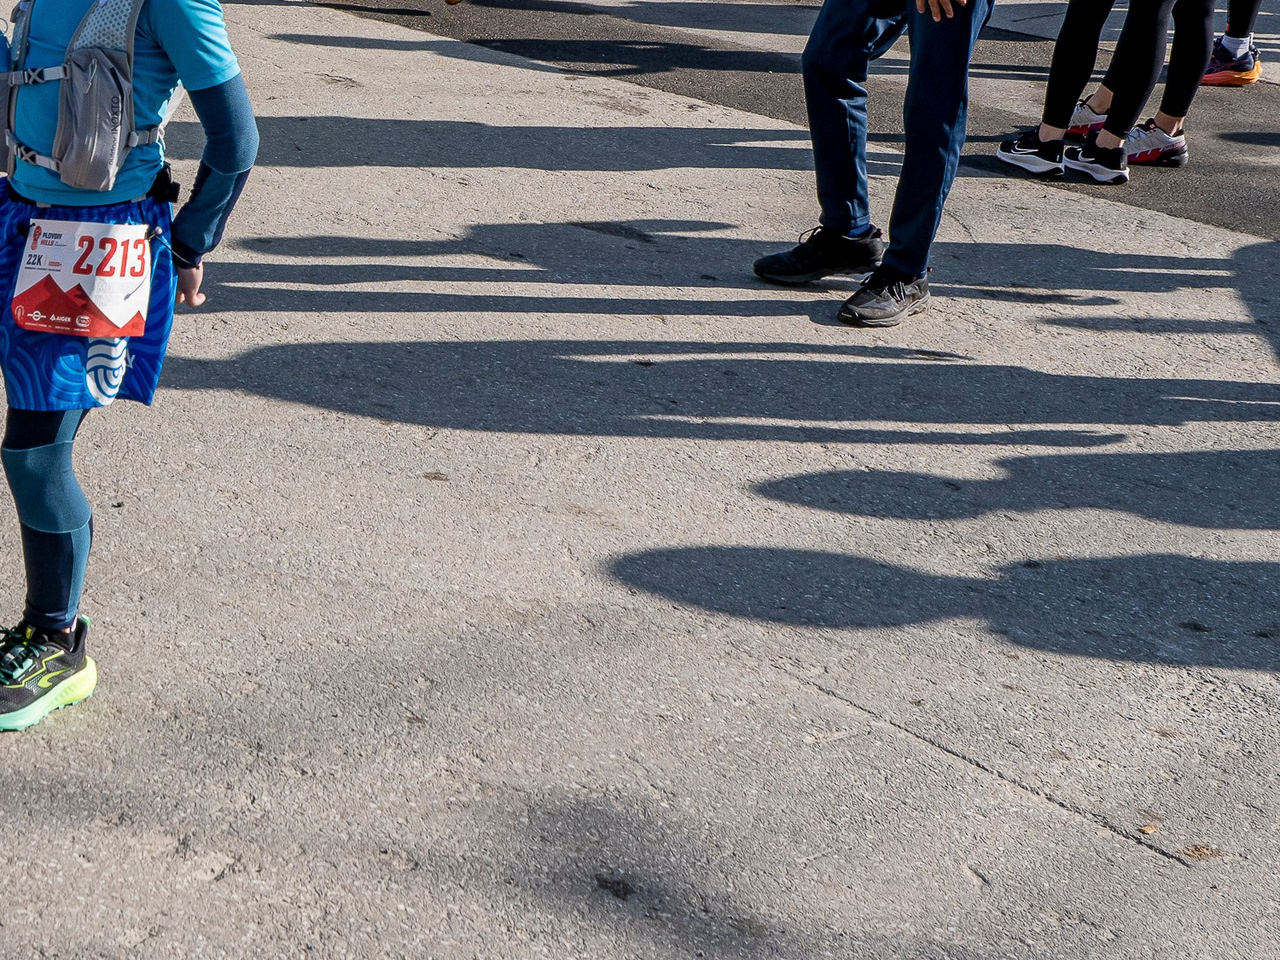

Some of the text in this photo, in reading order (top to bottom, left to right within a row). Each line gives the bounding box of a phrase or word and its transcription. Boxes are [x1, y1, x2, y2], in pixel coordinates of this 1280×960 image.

[110, 96, 120, 135] INOXTO
[26, 253, 43, 266] 22K
[72, 235, 146, 278] 2213
